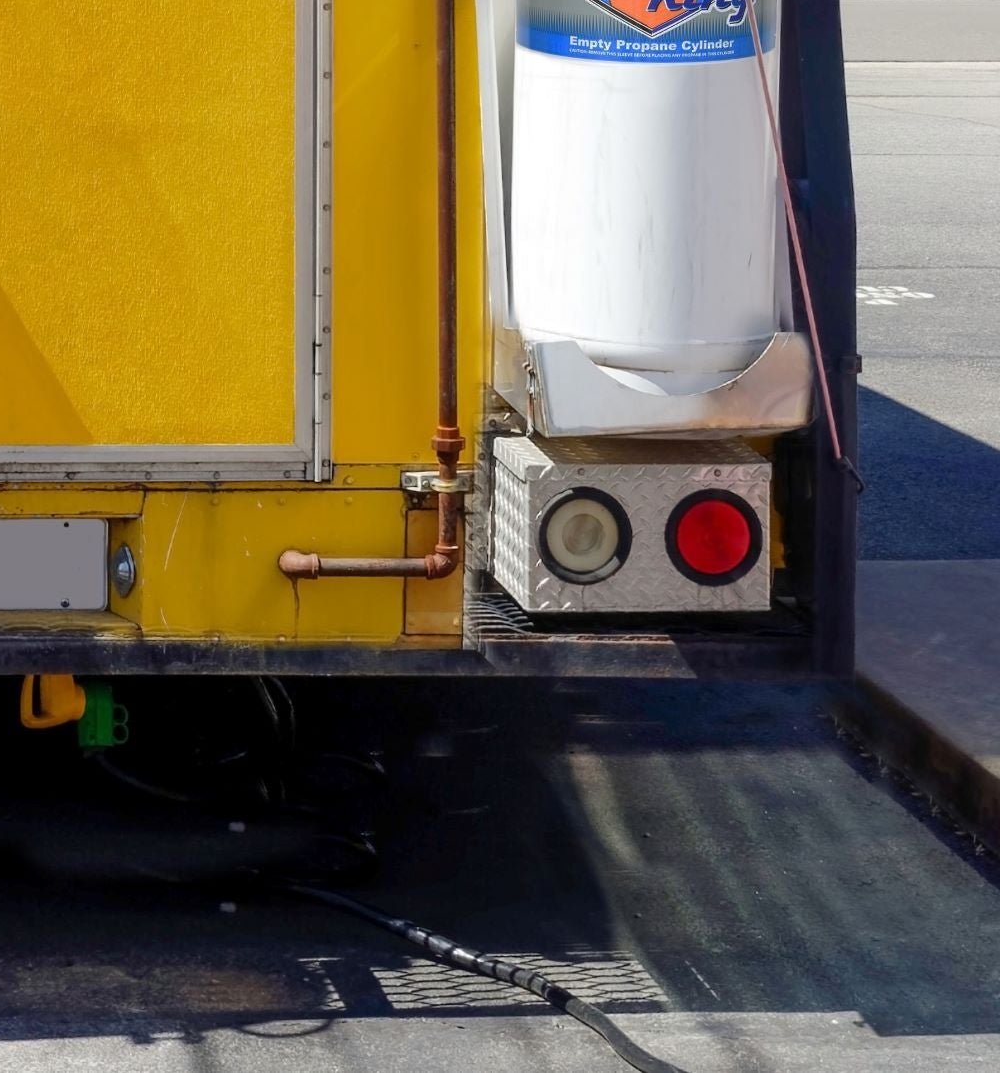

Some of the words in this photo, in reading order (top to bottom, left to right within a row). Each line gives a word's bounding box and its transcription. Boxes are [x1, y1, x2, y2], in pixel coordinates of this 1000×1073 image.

[569, 35, 612, 51] Empty
[616, 39, 677, 53] Propane
[681, 39, 735, 53] Cylinder
